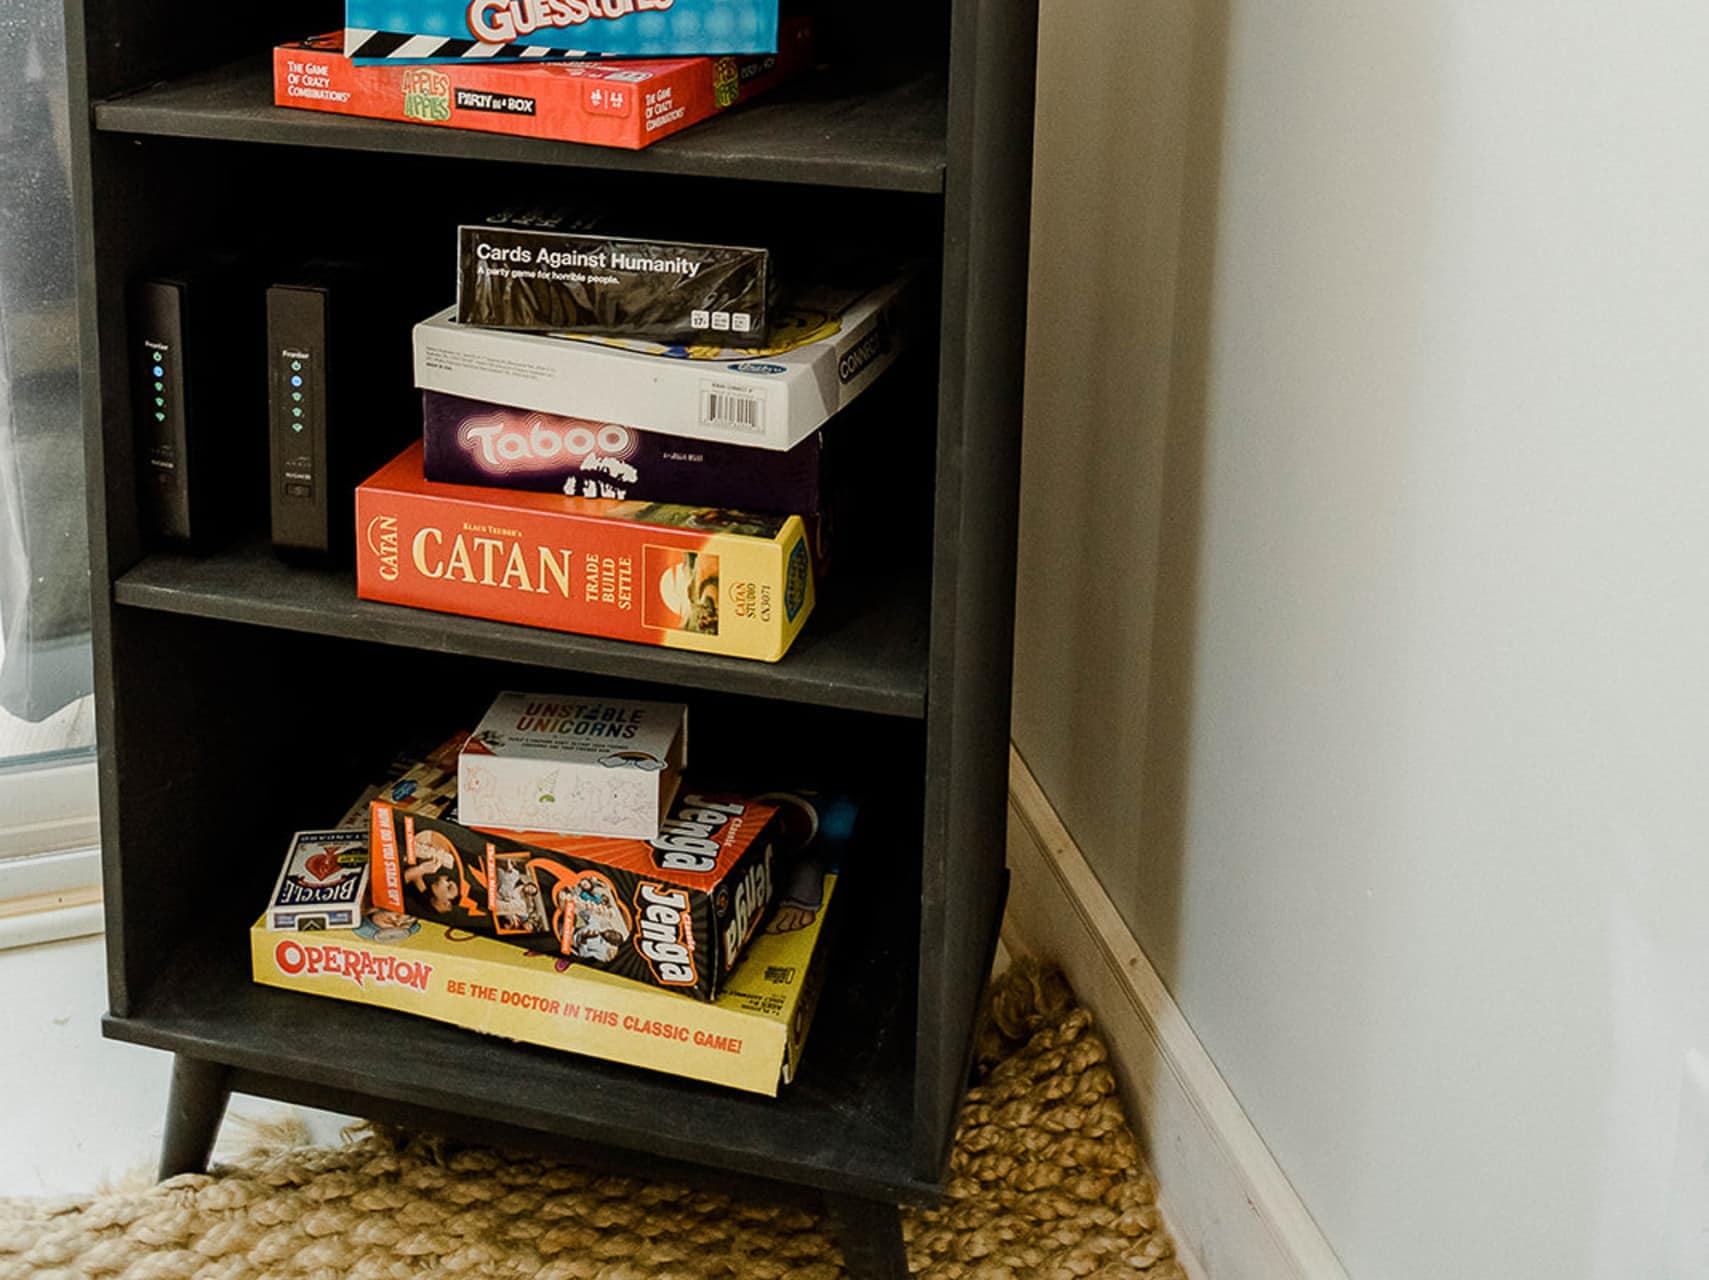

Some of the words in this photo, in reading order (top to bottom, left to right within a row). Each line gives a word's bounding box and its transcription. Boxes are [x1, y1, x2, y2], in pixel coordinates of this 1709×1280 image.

[287, 61, 303, 74] THE
[305, 62, 329, 75] GAME
[287, 73, 300, 85] OF
[302, 74, 330, 87] CRAZY
[402, 70, 449, 96] APPLES
[404, 93, 449, 119] APPLES
[457, 91, 493, 109] PARTY
[509, 97, 534, 112] BOX
[476, 243, 532, 263] Cards
[536, 247, 607, 269] Against
[611, 253, 701, 277] Humanity
[486, 267, 510, 279] party
[511, 269, 536, 280] game
[537, 270, 550, 280] for
[551, 271, 586, 283] horrible
[466, 421, 629, 464] Taboo
[380, 515, 399, 581] CATAN
[412, 527, 572, 598] CATAN
[585, 553, 599, 603] TRADE
[602, 558, 616, 604] BUILD
[618, 557, 632, 610] SETTLE
[735, 582, 747, 617] CATAN
[747, 583, 757, 619] STUDIO
[516, 716, 639, 739] UNICORNS
[525, 702, 647, 724] UNSTABLE
[651, 794, 745, 872] Jenga
[281, 875, 357, 904] BICYCLE
[384, 861, 399, 888] STACK
[726, 843, 774, 966] Jenga
[640, 885, 695, 983] Jenga
[275, 940, 433, 991] OPERATION
[447, 980, 465, 995] BE
[470, 984, 498, 1001] THE
[500, 990, 560, 1014] DOCTOR
[562, 1002, 580, 1018] IN
[584, 1007, 619, 1027] THIS
[623, 1015, 690, 1042] CLASSIC
[693, 1030, 743, 1054] GAME!
